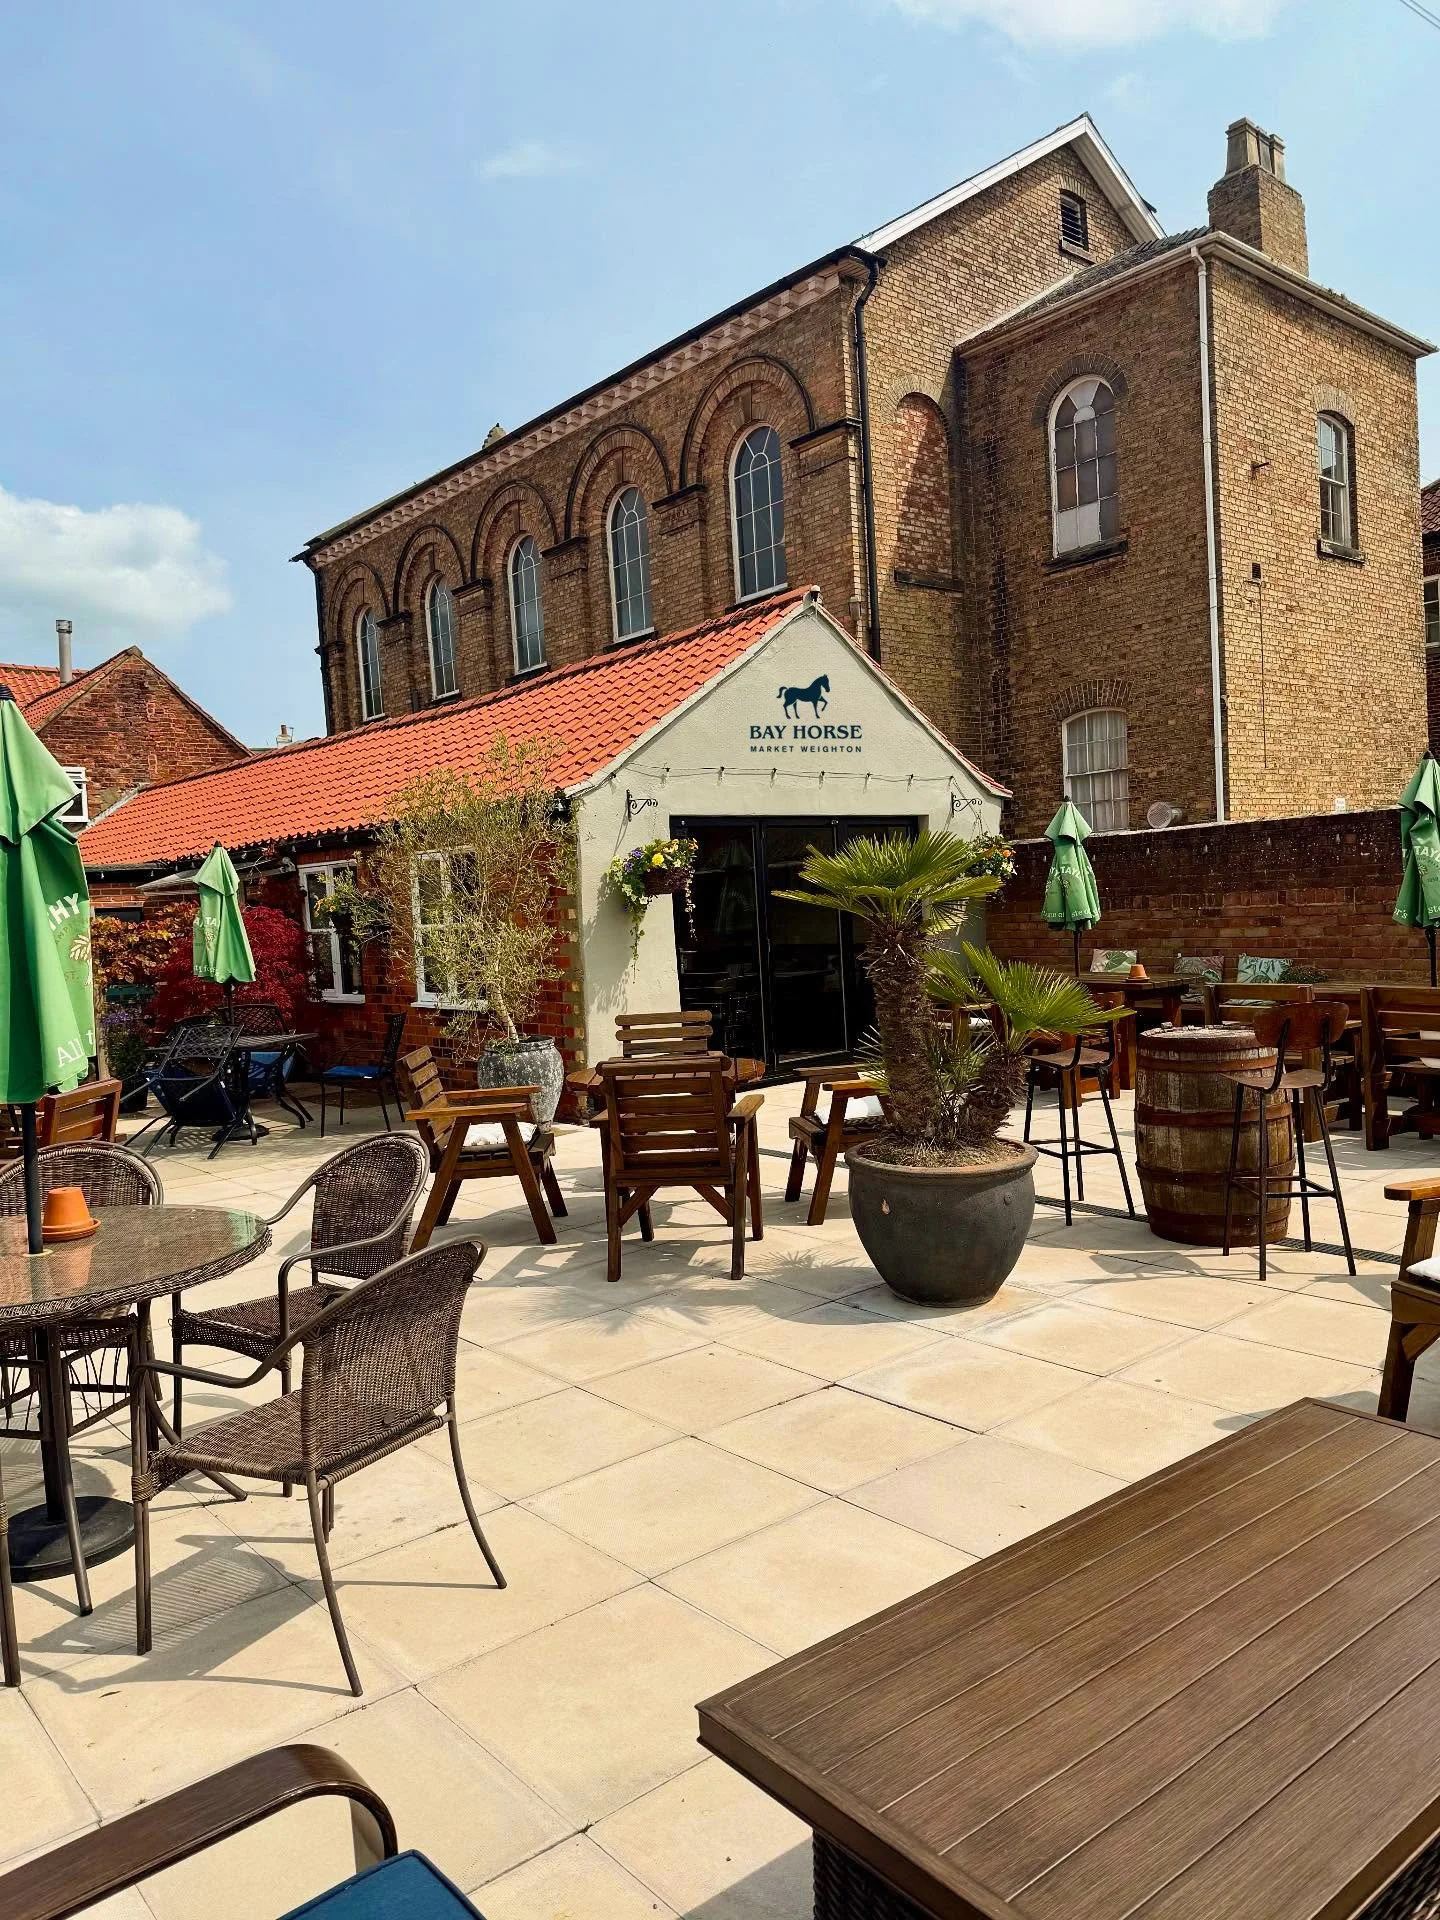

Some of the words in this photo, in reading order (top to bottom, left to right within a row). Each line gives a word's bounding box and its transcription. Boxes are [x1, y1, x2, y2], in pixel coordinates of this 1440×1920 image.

[749, 725, 787, 740] BAY
[793, 725, 863, 740] HORSE
[750, 745, 795, 753] MARKET
[800, 745, 862, 753] WEIGHTON
